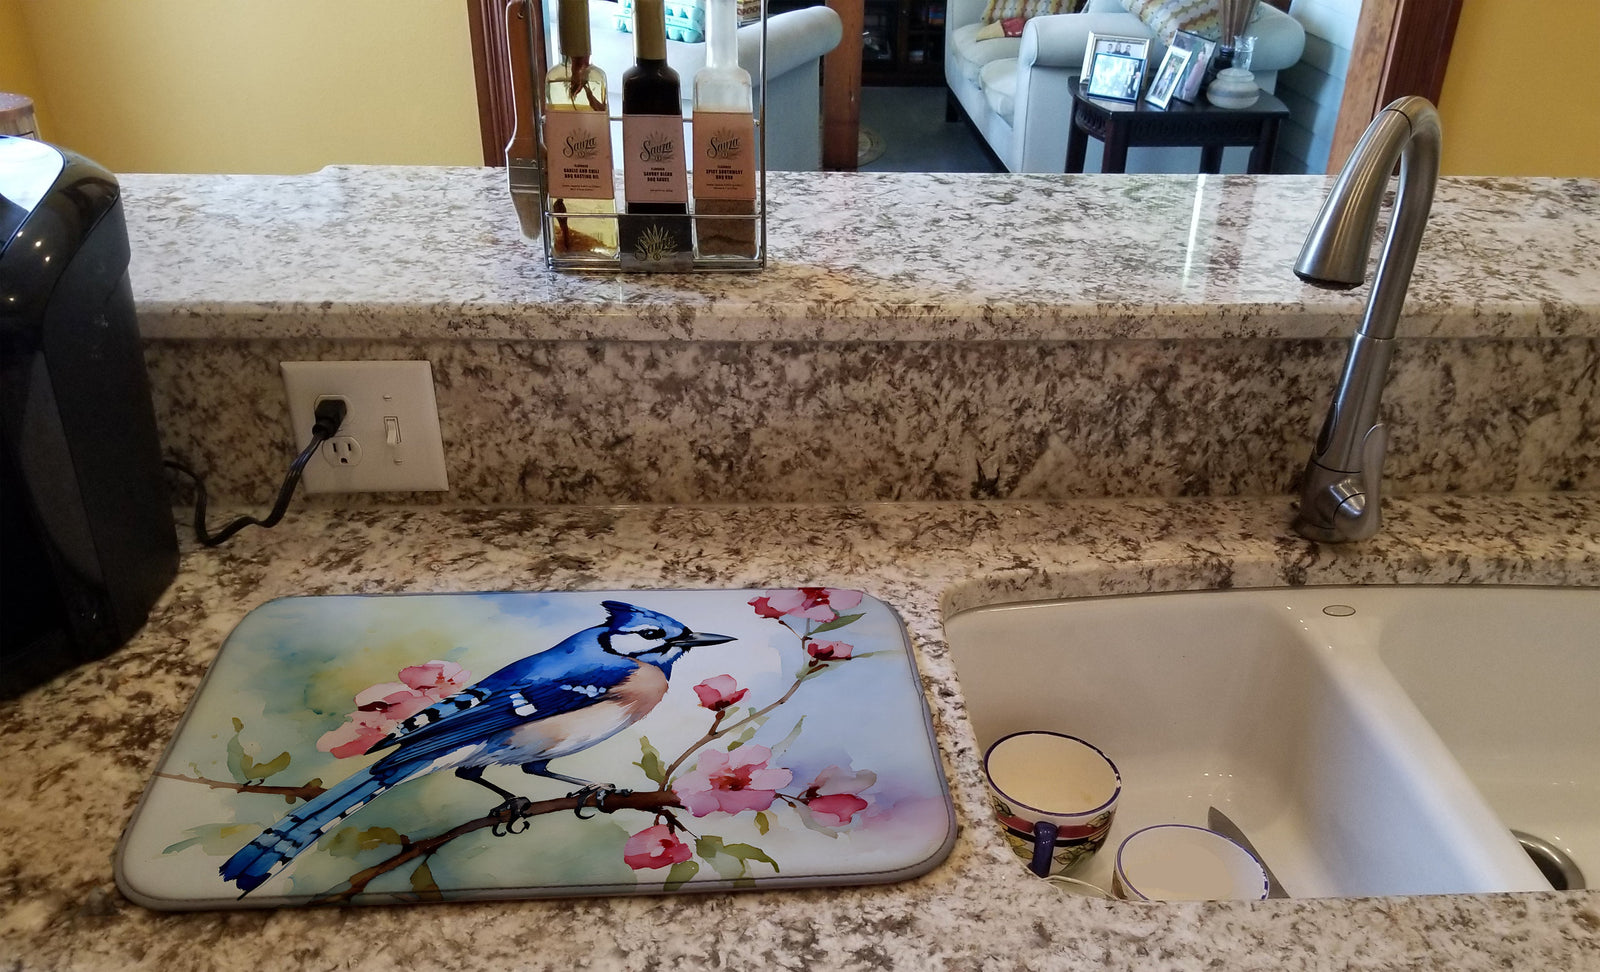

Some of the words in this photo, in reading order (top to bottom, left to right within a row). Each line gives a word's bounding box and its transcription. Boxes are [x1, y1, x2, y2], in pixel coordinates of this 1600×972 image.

[563, 136, 597, 158] Sauza
[640, 139, 673, 162] Sauza
[707, 137, 740, 159] Sauza
